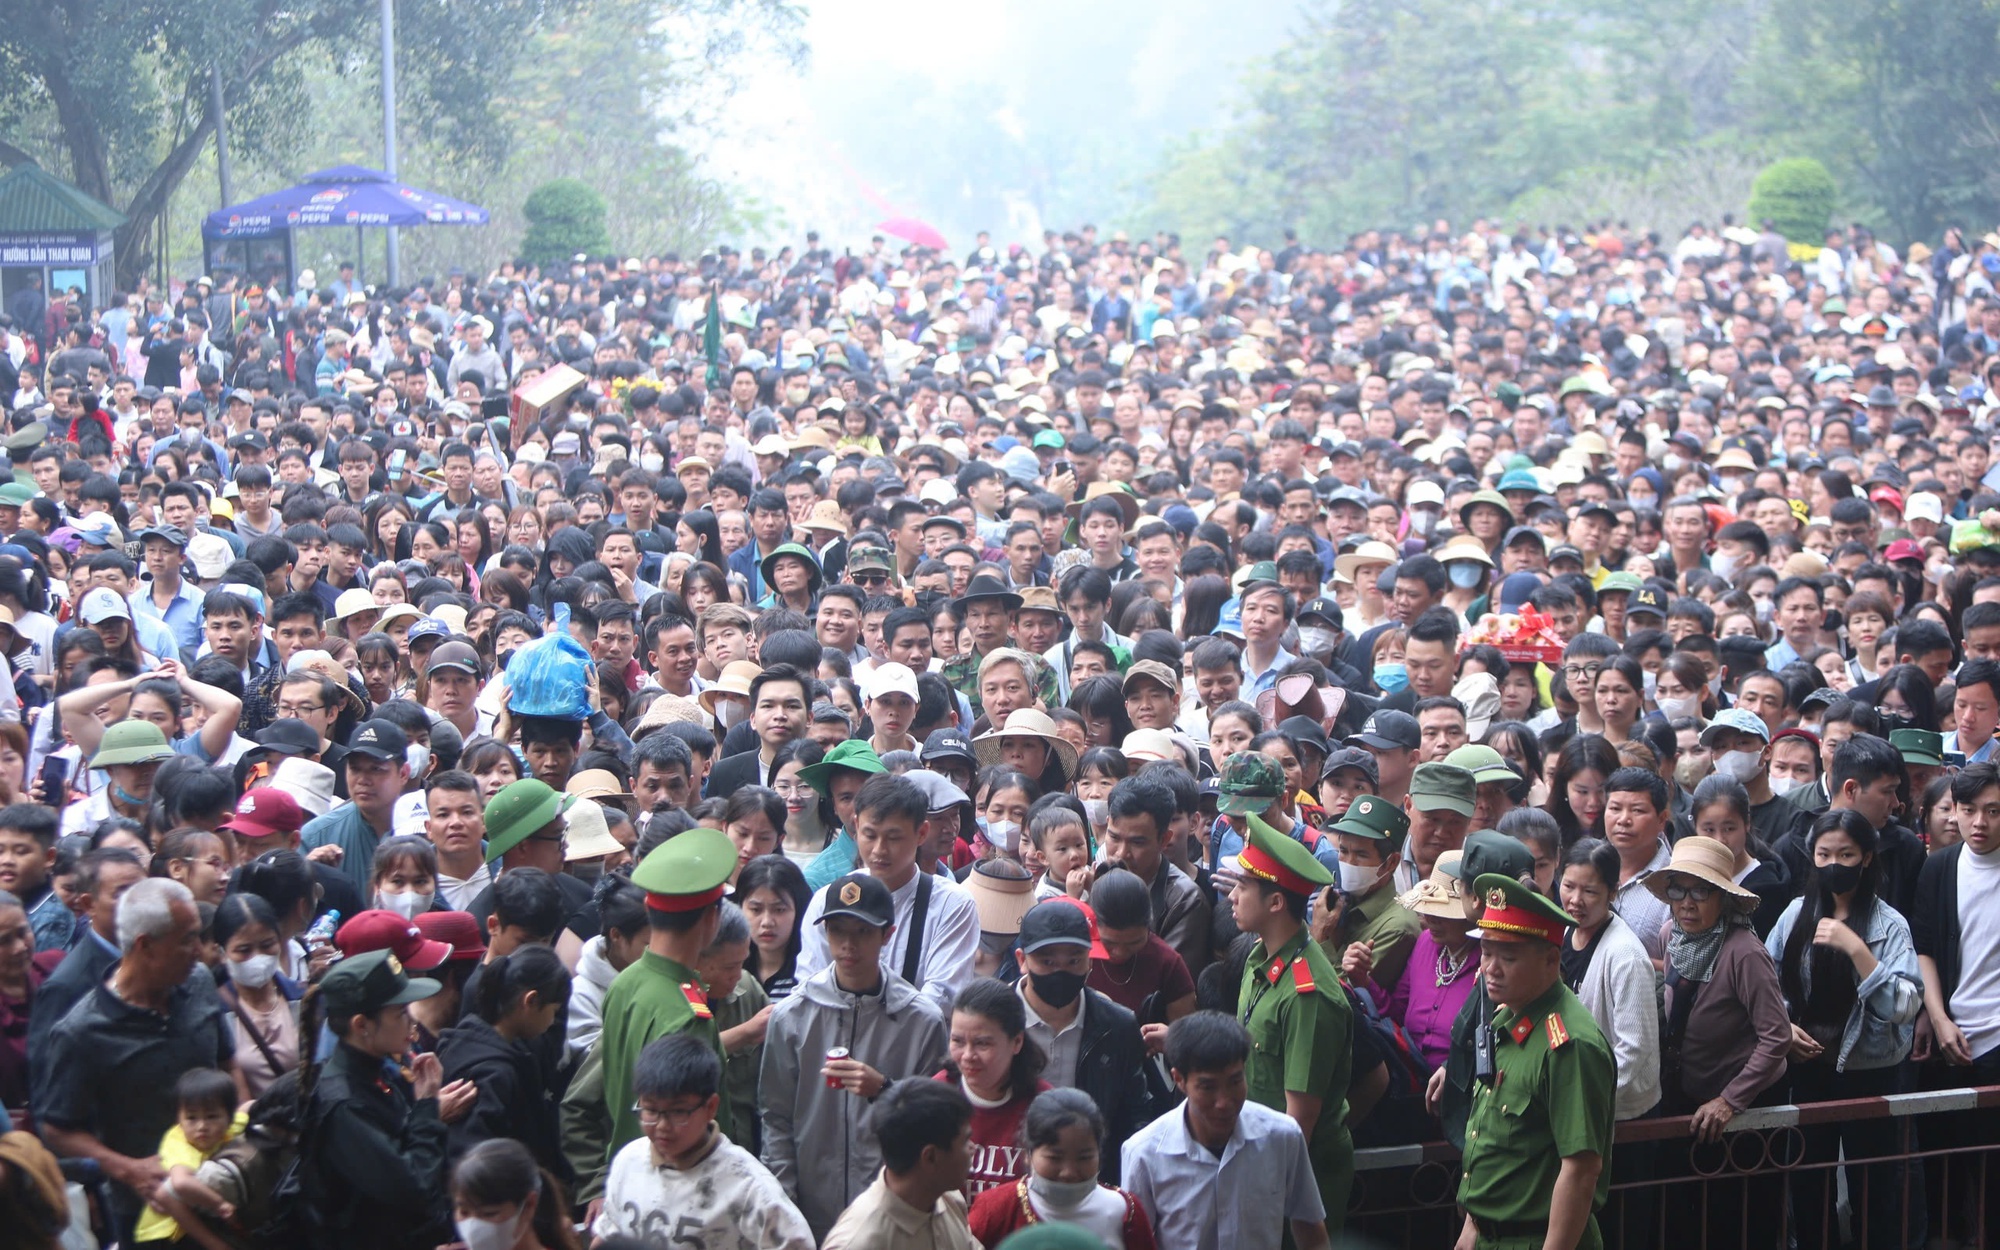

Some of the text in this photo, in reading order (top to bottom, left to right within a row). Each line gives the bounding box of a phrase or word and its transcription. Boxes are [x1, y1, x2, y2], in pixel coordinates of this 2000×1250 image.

[243, 215, 271, 226] PEPSI
[301, 213, 330, 224] PEPSI
[360, 213, 389, 224] PEPSI
[48, 247, 70, 262] THAM
[70, 247, 92, 263] QUAN
[1637, 590, 1657, 605] LA
[1313, 601, 1324, 611] H
[968, 1144, 1023, 1177] OLY
[623, 1200, 707, 1250] 365
